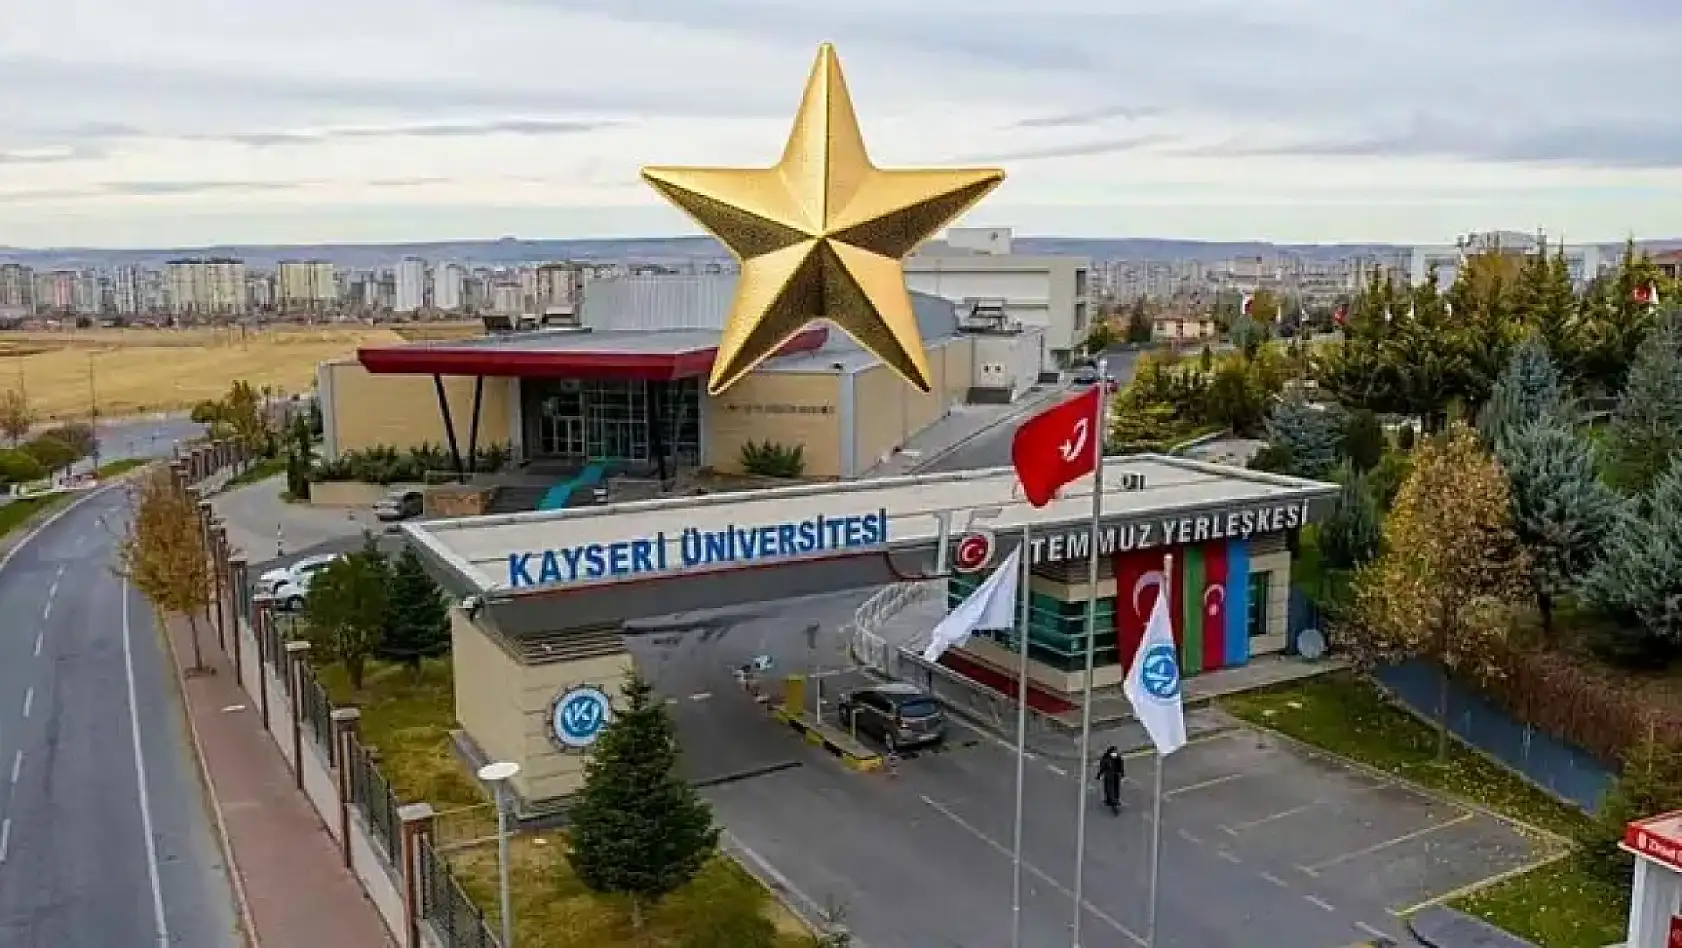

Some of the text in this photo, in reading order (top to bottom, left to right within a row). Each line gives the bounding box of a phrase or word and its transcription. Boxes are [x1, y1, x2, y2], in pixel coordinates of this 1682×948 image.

[510, 508, 886, 587] KAYSERİ ÜNİVERSİTESİ
[1031, 523, 1151, 564] TEMMUZ
[1163, 498, 1310, 545] YERLEŞKESİ
